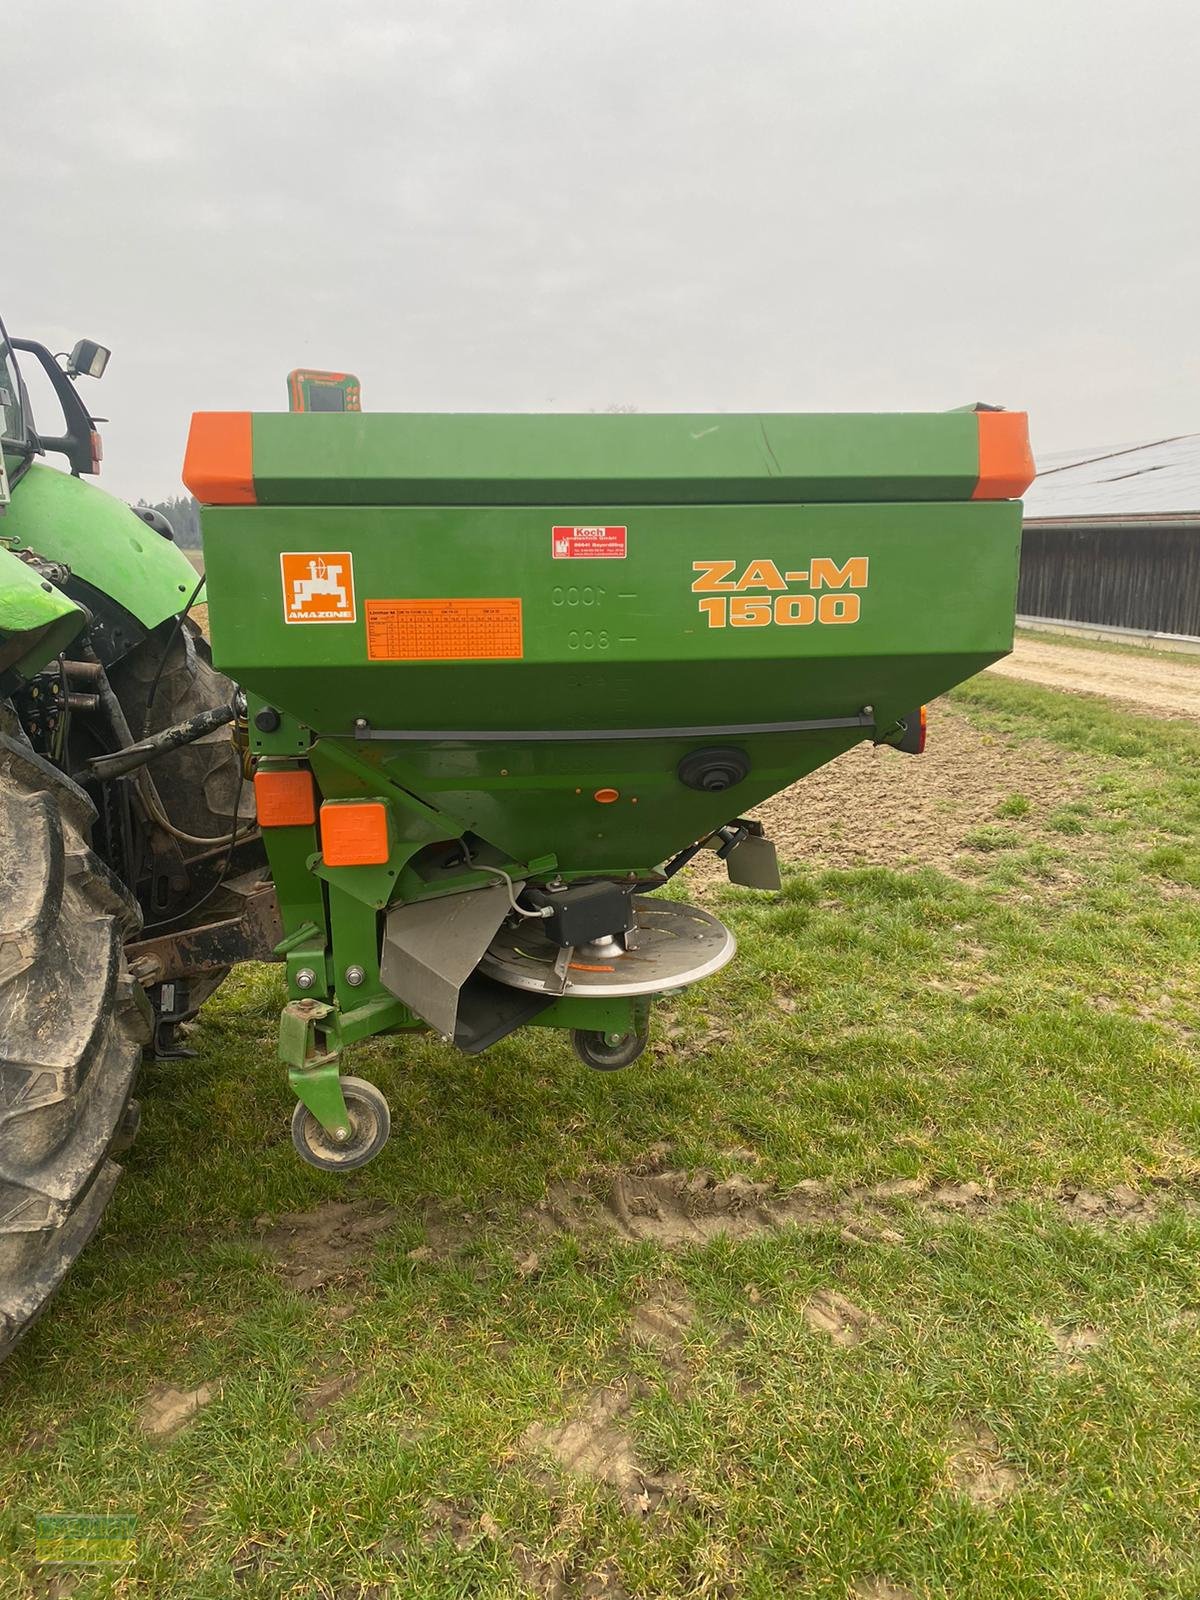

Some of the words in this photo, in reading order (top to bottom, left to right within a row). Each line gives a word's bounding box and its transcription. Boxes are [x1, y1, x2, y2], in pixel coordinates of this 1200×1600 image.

[576, 528, 603, 536] Koch
[691, 556, 869, 592] ZA-M
[288, 611, 352, 619] AMAZONE
[698, 593, 861, 628] 1500
